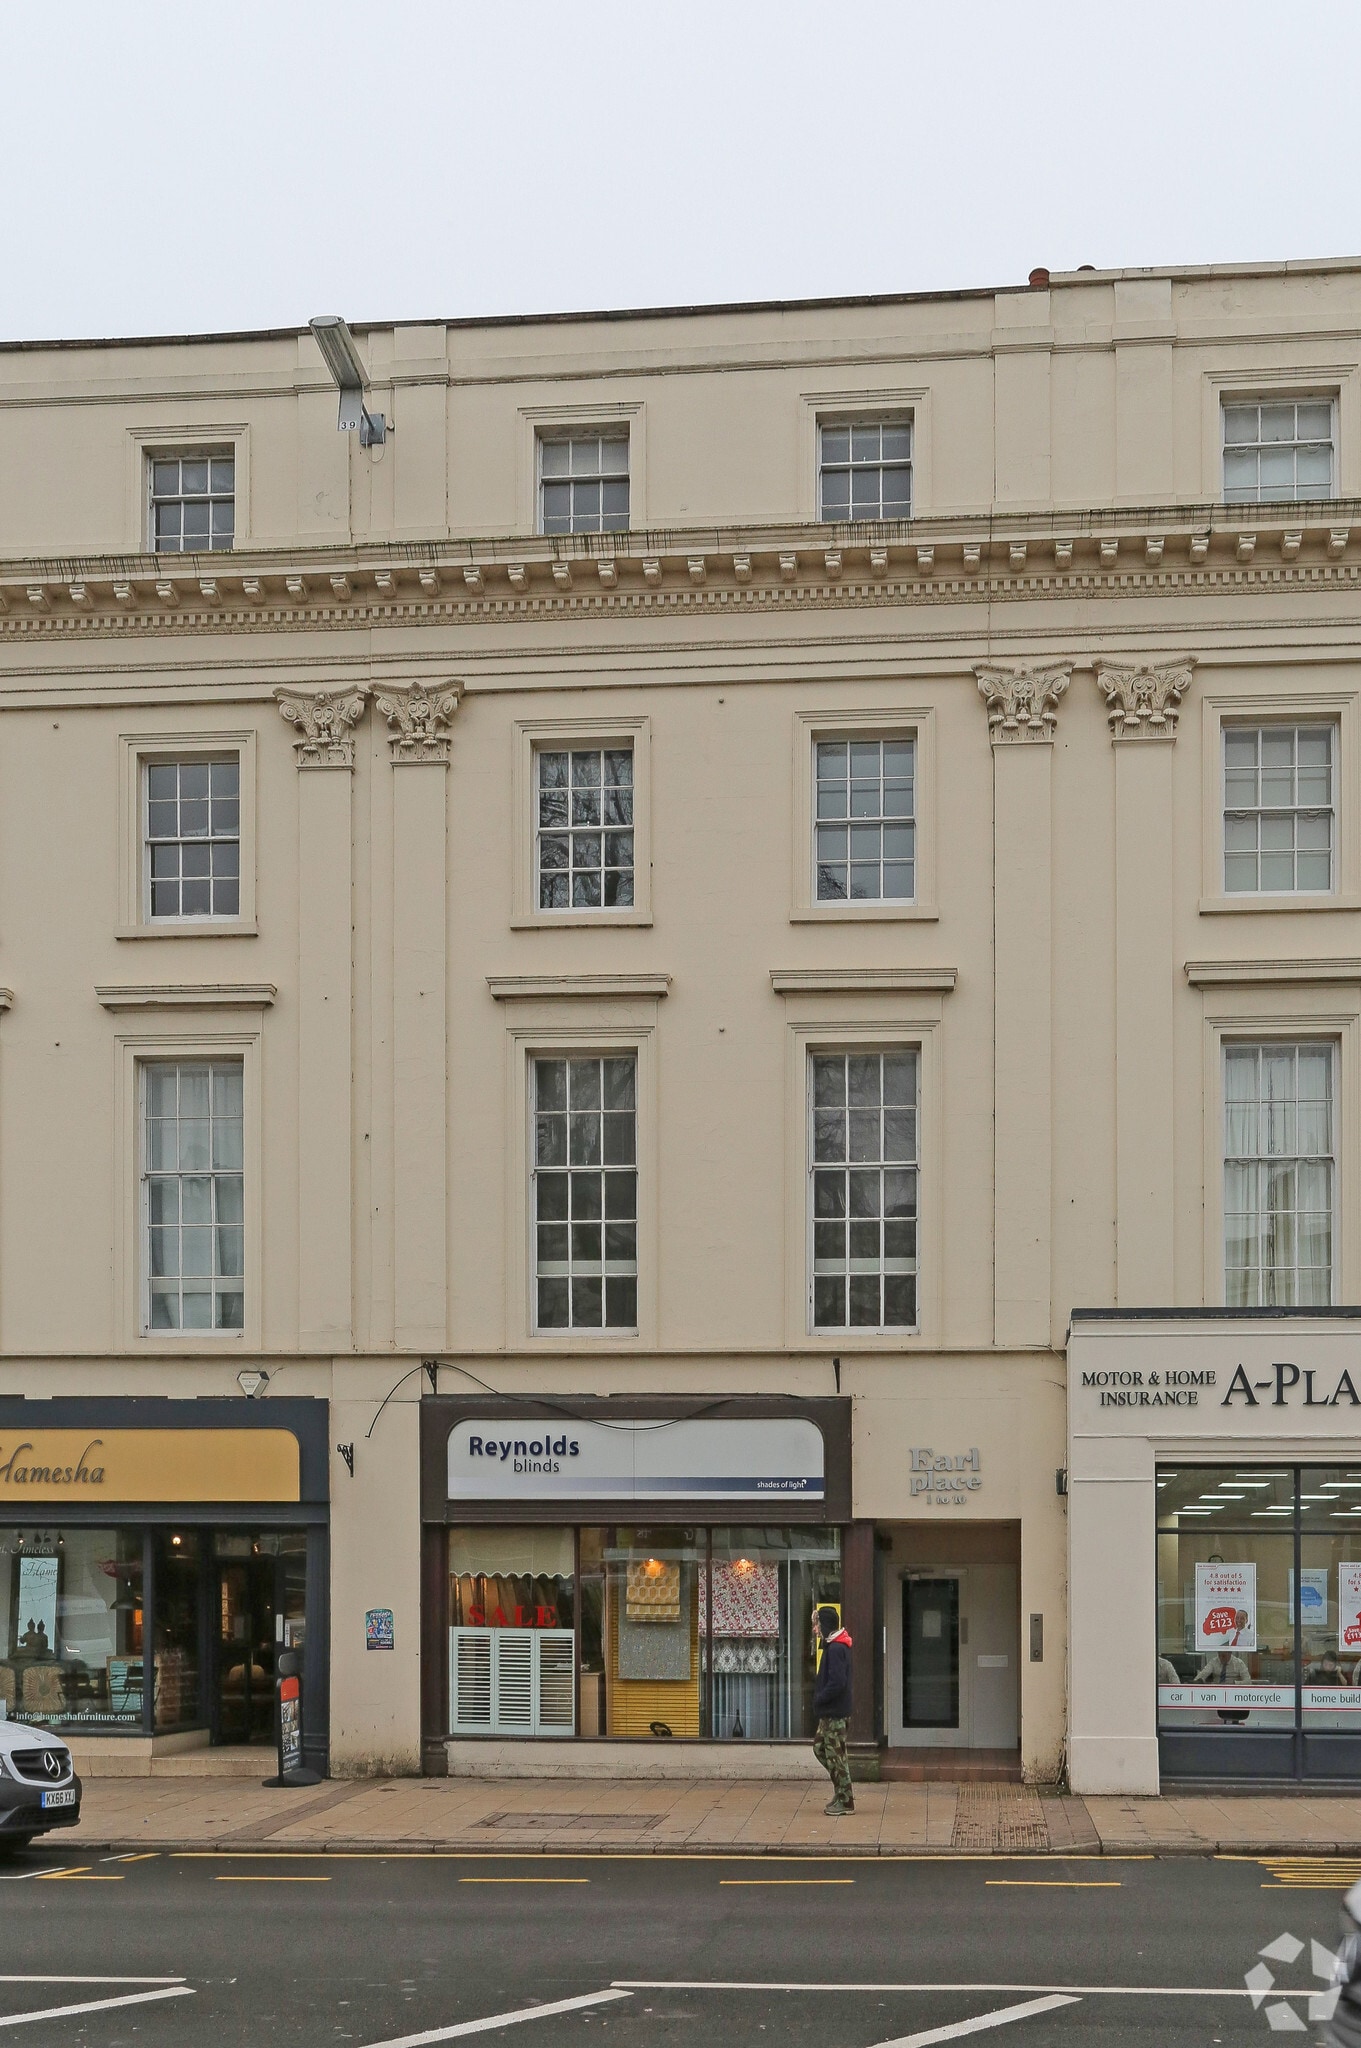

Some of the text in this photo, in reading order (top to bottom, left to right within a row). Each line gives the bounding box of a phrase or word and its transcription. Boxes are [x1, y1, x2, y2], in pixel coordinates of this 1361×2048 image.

[341, 421, 356, 430] 39
[1081, 1370, 1216, 1386] MOTOR & HOME
[1100, 1391, 1198, 1406] INSURANCE
[469, 1435, 580, 1461] Reynolds
[513, 1459, 560, 1473] blinds
[909, 1447, 980, 1472] Earl
[789, 1480, 805, 1490] light
[910, 1470, 982, 1497] place
[467, 1604, 557, 1628] SALE
[1212, 1611, 1229, 1619] Save
[1210, 1617, 1233, 1629] £123
[1170, 1693, 1184, 1701] car
[1234, 1693, 1281, 1704] motorcycle
[1311, 1693, 1337, 1703] home
[1340, 1693, 1361, 1703] build
[16, 1712, 136, 1721] info@hameshafurniture.com
